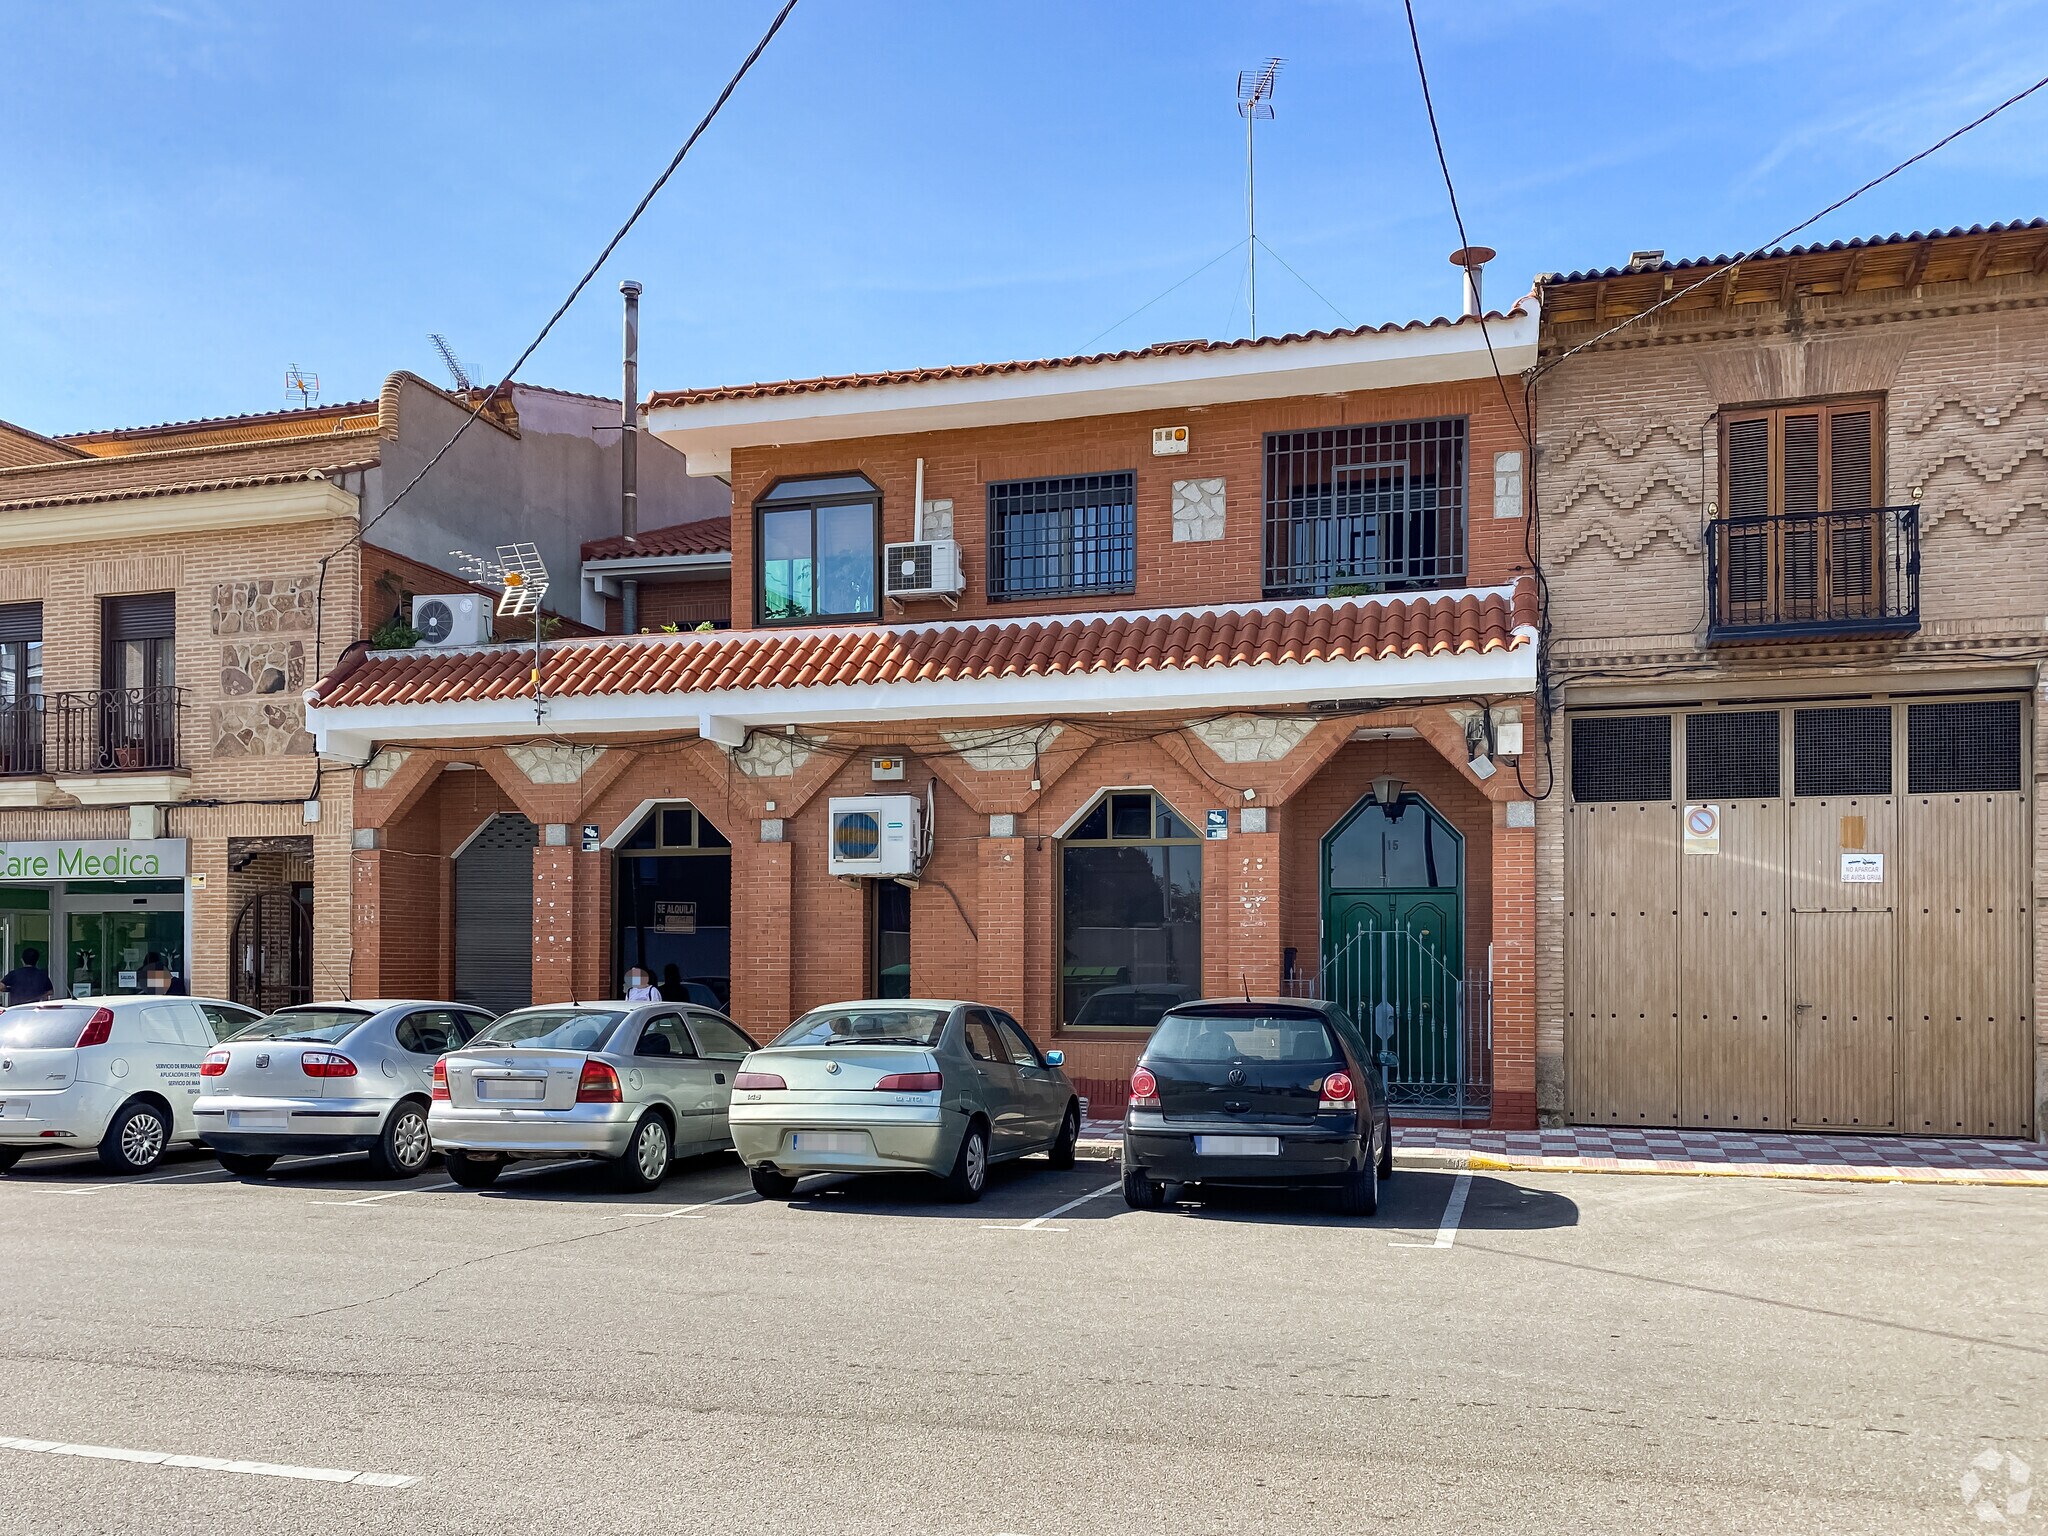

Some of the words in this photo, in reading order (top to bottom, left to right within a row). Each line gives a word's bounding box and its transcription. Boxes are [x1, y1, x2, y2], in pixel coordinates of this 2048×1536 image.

[0, 850, 48, 877] are
[58, 847, 159, 876] Medica
[657, 904, 666, 914] SE
[667, 904, 694, 914] ALQUILA
